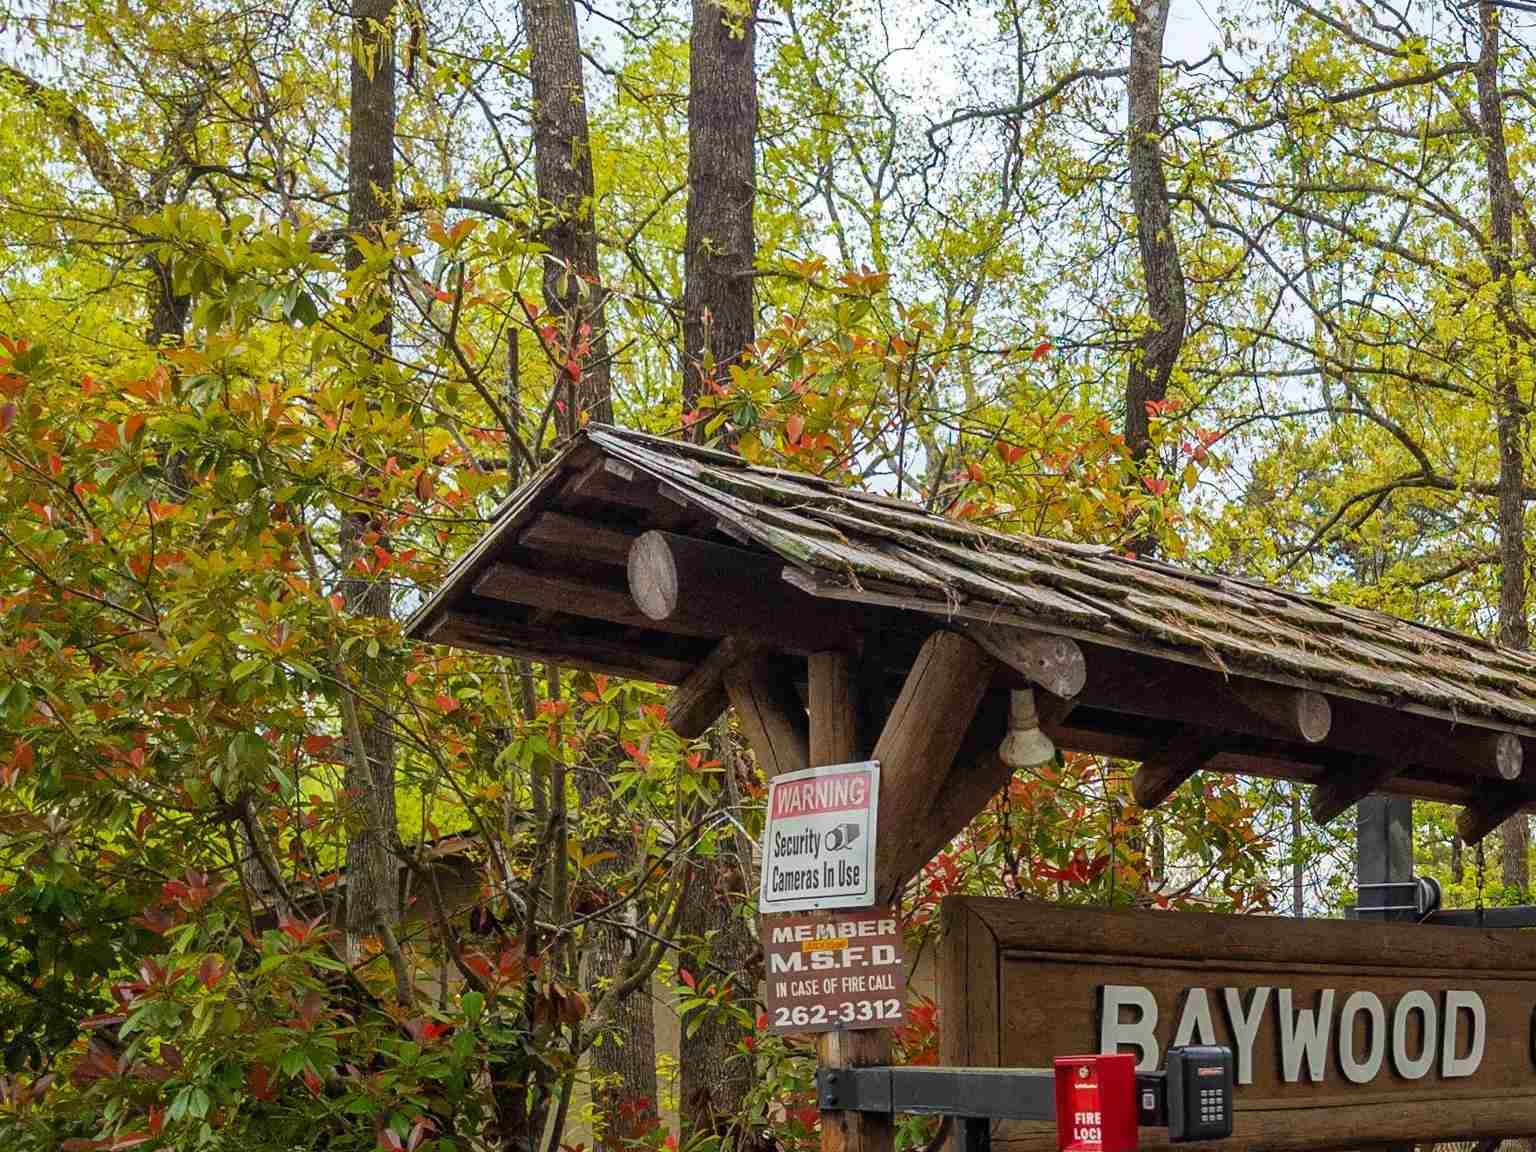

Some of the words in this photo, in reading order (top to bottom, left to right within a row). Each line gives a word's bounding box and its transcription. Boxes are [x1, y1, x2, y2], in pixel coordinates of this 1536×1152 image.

[776, 777, 864, 814] WARNING
[774, 828, 820, 859] Security
[772, 865, 819, 892] Cameras
[823, 861, 834, 888] In
[838, 859, 860, 887] Use
[772, 920, 896, 944] MEMBER
[770, 945, 902, 973] M.S.F.D.
[776, 981, 787, 998] IN
[791, 980, 819, 997] CASE
[823, 978, 838, 994] OF
[842, 976, 866, 992] FIRE
[868, 974, 895, 991] CALL
[775, 999, 902, 1026] 262-3312
[1101, 984, 1487, 1085] BAYWOOD
[1074, 1112, 1102, 1125] FIRE
